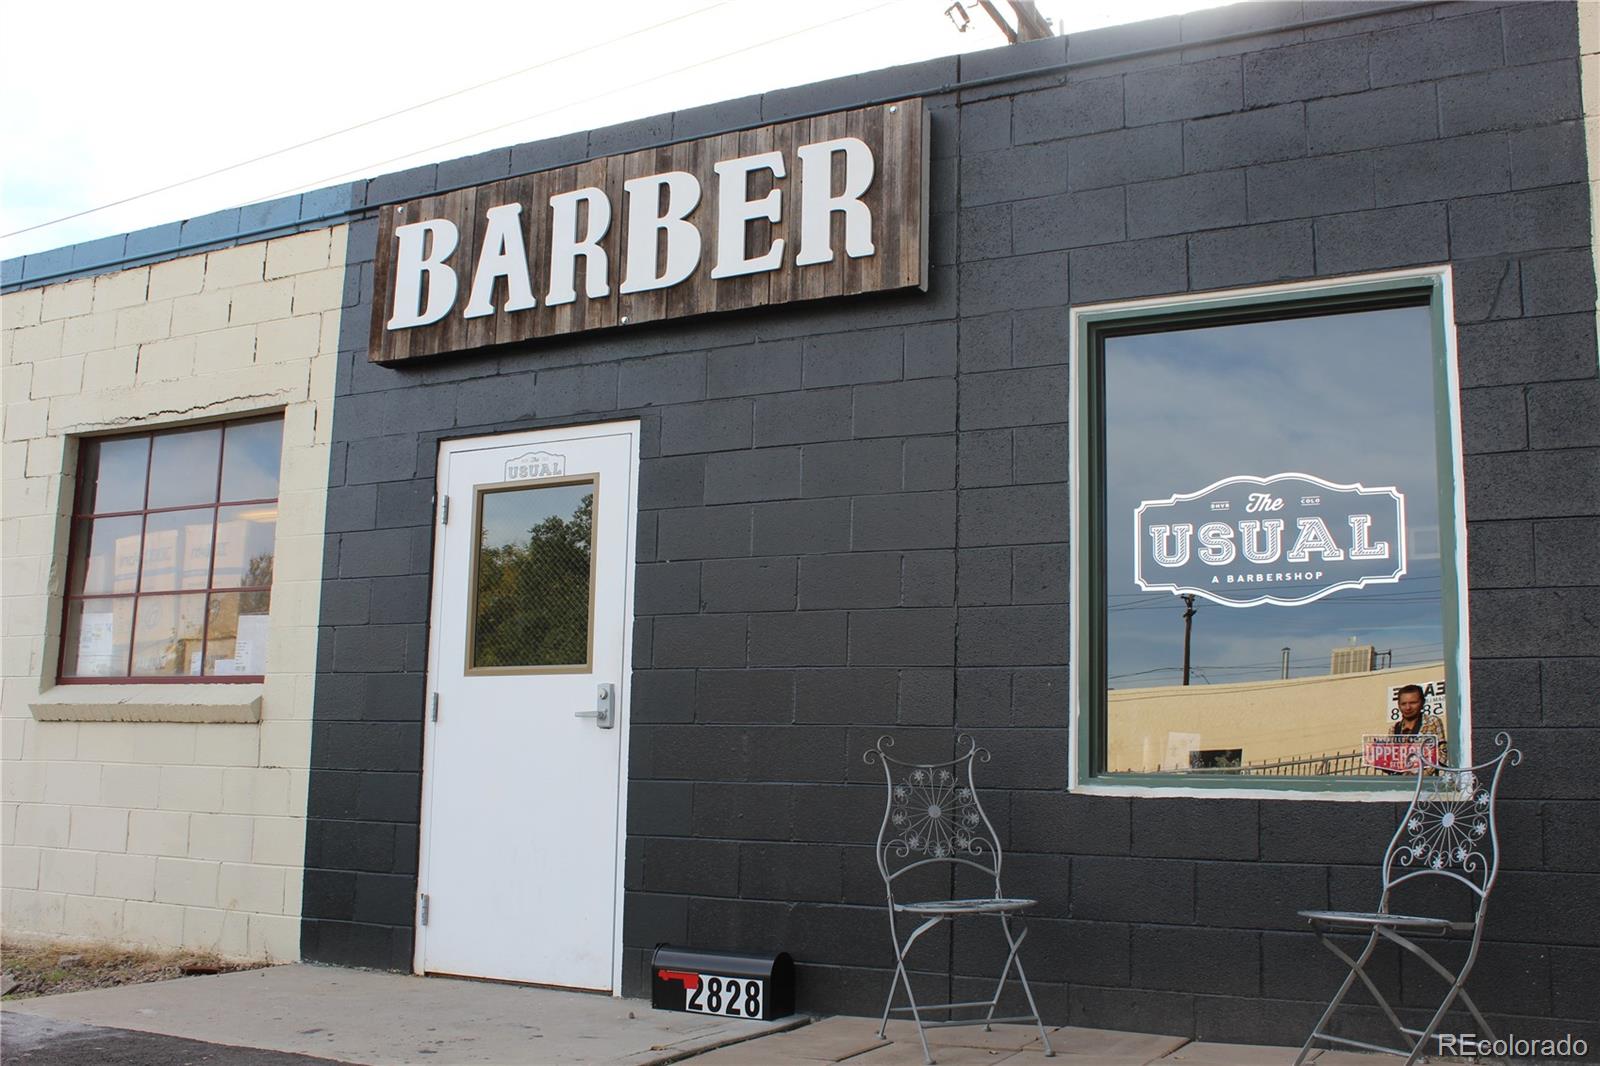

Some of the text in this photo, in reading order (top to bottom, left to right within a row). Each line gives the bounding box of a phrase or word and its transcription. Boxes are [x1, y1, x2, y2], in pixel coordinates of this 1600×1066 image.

[387, 137, 875, 331] BARBER
[508, 463, 562, 479] USUAL
[1245, 493, 1284, 513] The
[1149, 514, 1389, 567] USUAL
[1212, 572, 1323, 583] A BARBERSHOP
[688, 973, 760, 1018] 2828
